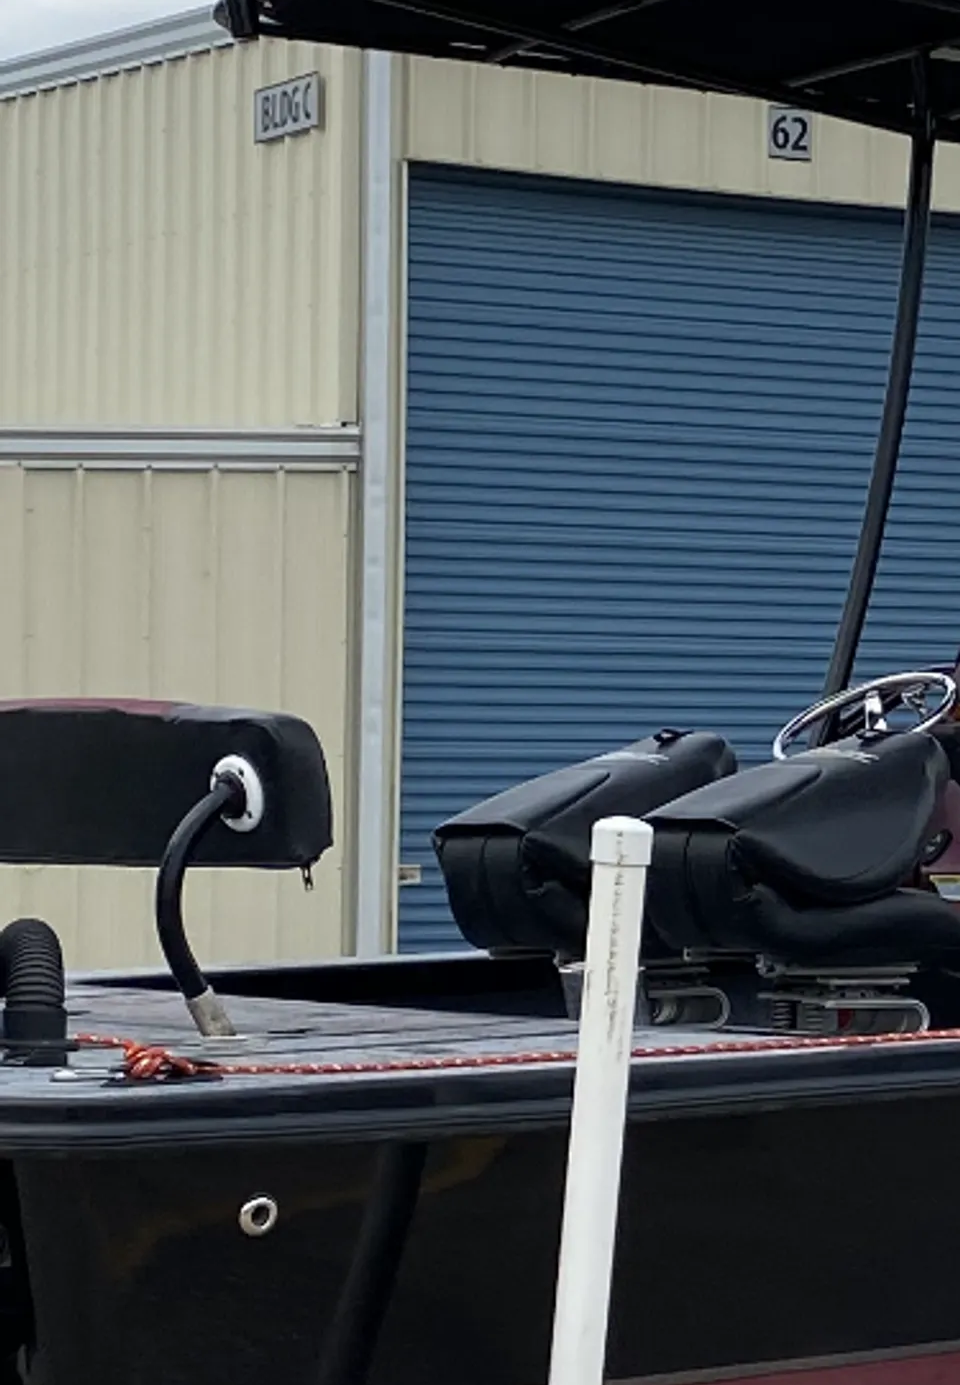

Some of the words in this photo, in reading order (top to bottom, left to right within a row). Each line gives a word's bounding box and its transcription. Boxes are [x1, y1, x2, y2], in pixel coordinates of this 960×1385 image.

[262, 86, 300, 133] BLDG
[302, 81, 311, 120] C
[772, 115, 808, 151] 62
